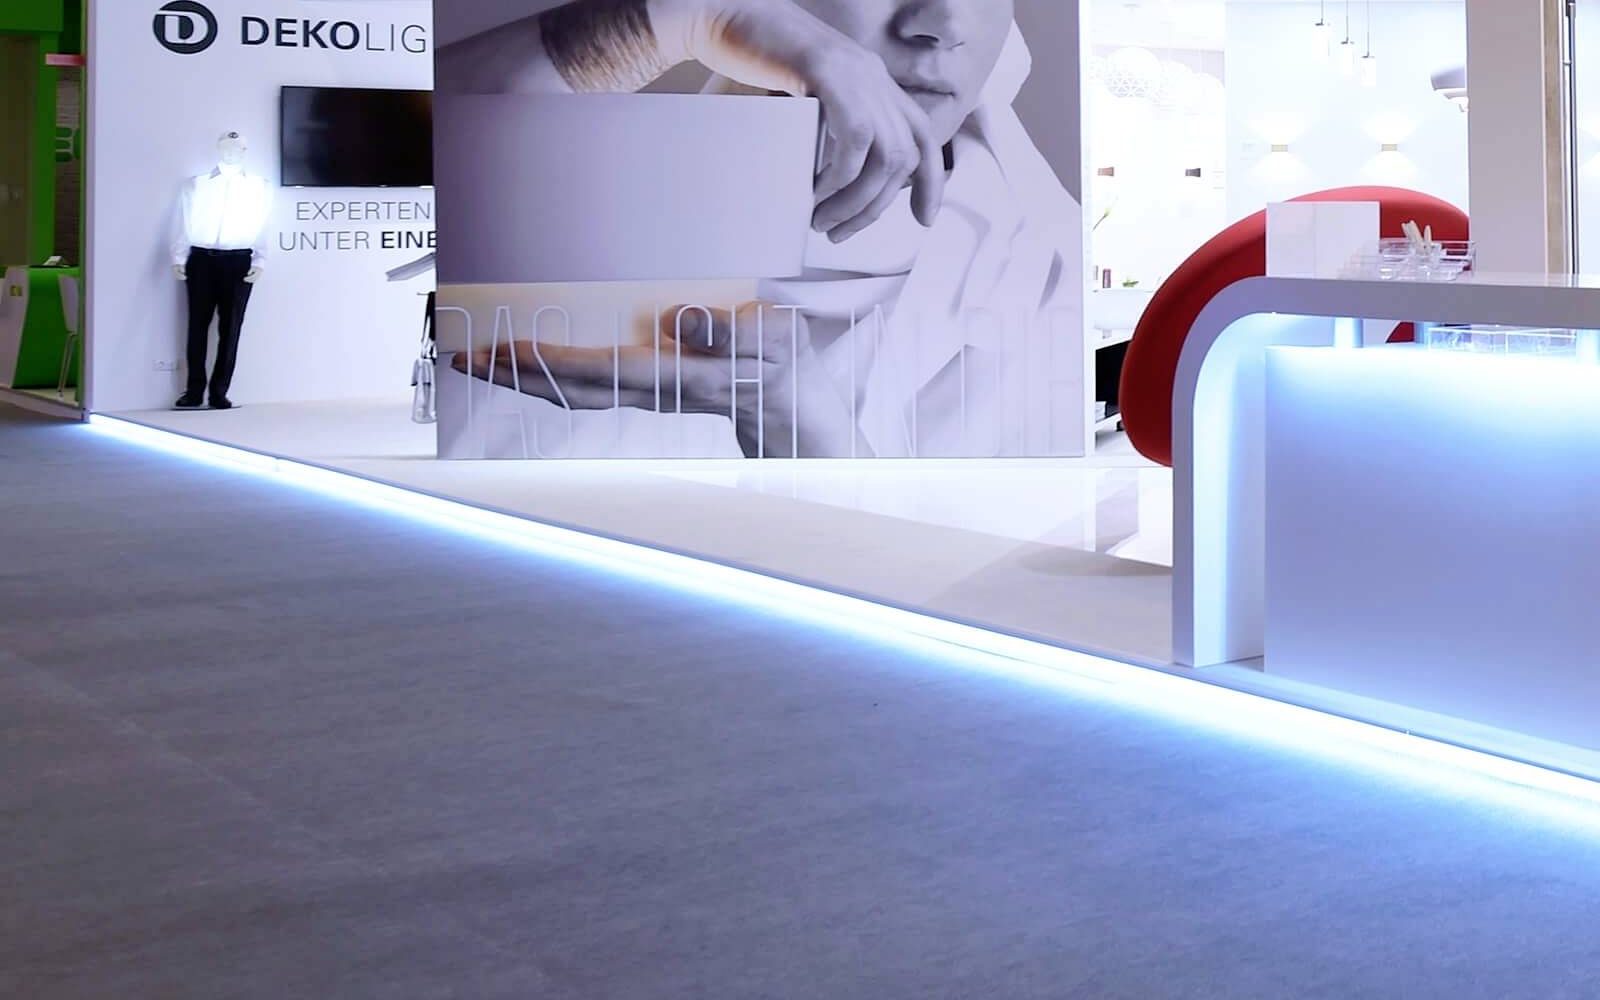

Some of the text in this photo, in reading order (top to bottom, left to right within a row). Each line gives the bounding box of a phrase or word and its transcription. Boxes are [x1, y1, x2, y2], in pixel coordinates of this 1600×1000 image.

[240, 16, 428, 53] DEKOLIG
[296, 201, 431, 221] EXPERTEN
[279, 231, 370, 251] UNTER
